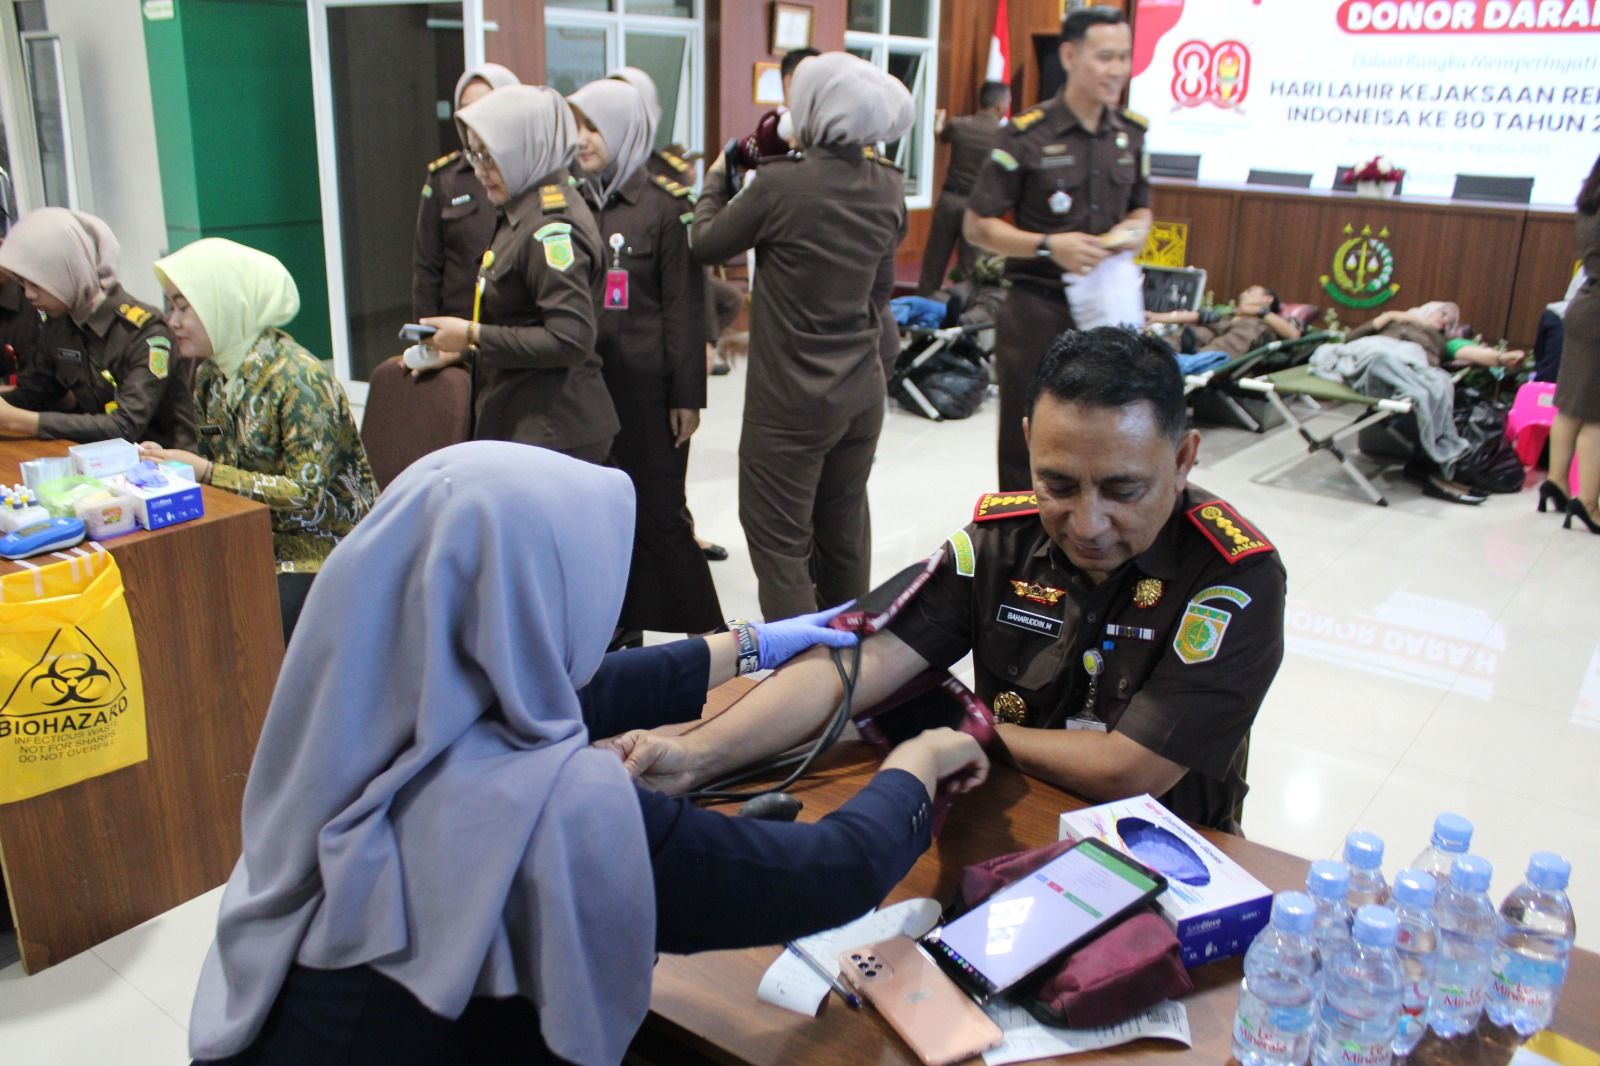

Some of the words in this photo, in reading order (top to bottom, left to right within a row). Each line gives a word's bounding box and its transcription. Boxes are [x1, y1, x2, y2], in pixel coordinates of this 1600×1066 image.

[1347, 0, 1476, 30] DONOR
[1270, 80, 1325, 98] HARI
[1328, 81, 1393, 100] LAHIR
[1400, 83, 1555, 104] KEJAKSAAN
[1287, 107, 1411, 126] INDONEISA
[1418, 109, 1448, 127] KE
[1453, 110, 1486, 129] 80
[1494, 111, 1586, 132] TAHUN
[0, 696, 128, 737] BIOHAZARD
[15, 730, 85, 745] INFECTIOUS
[20, 745, 46, 754] NOT
[48, 741, 72, 752] FOR
[18, 754, 37, 763] DO
[40, 752, 63, 762] NOT
